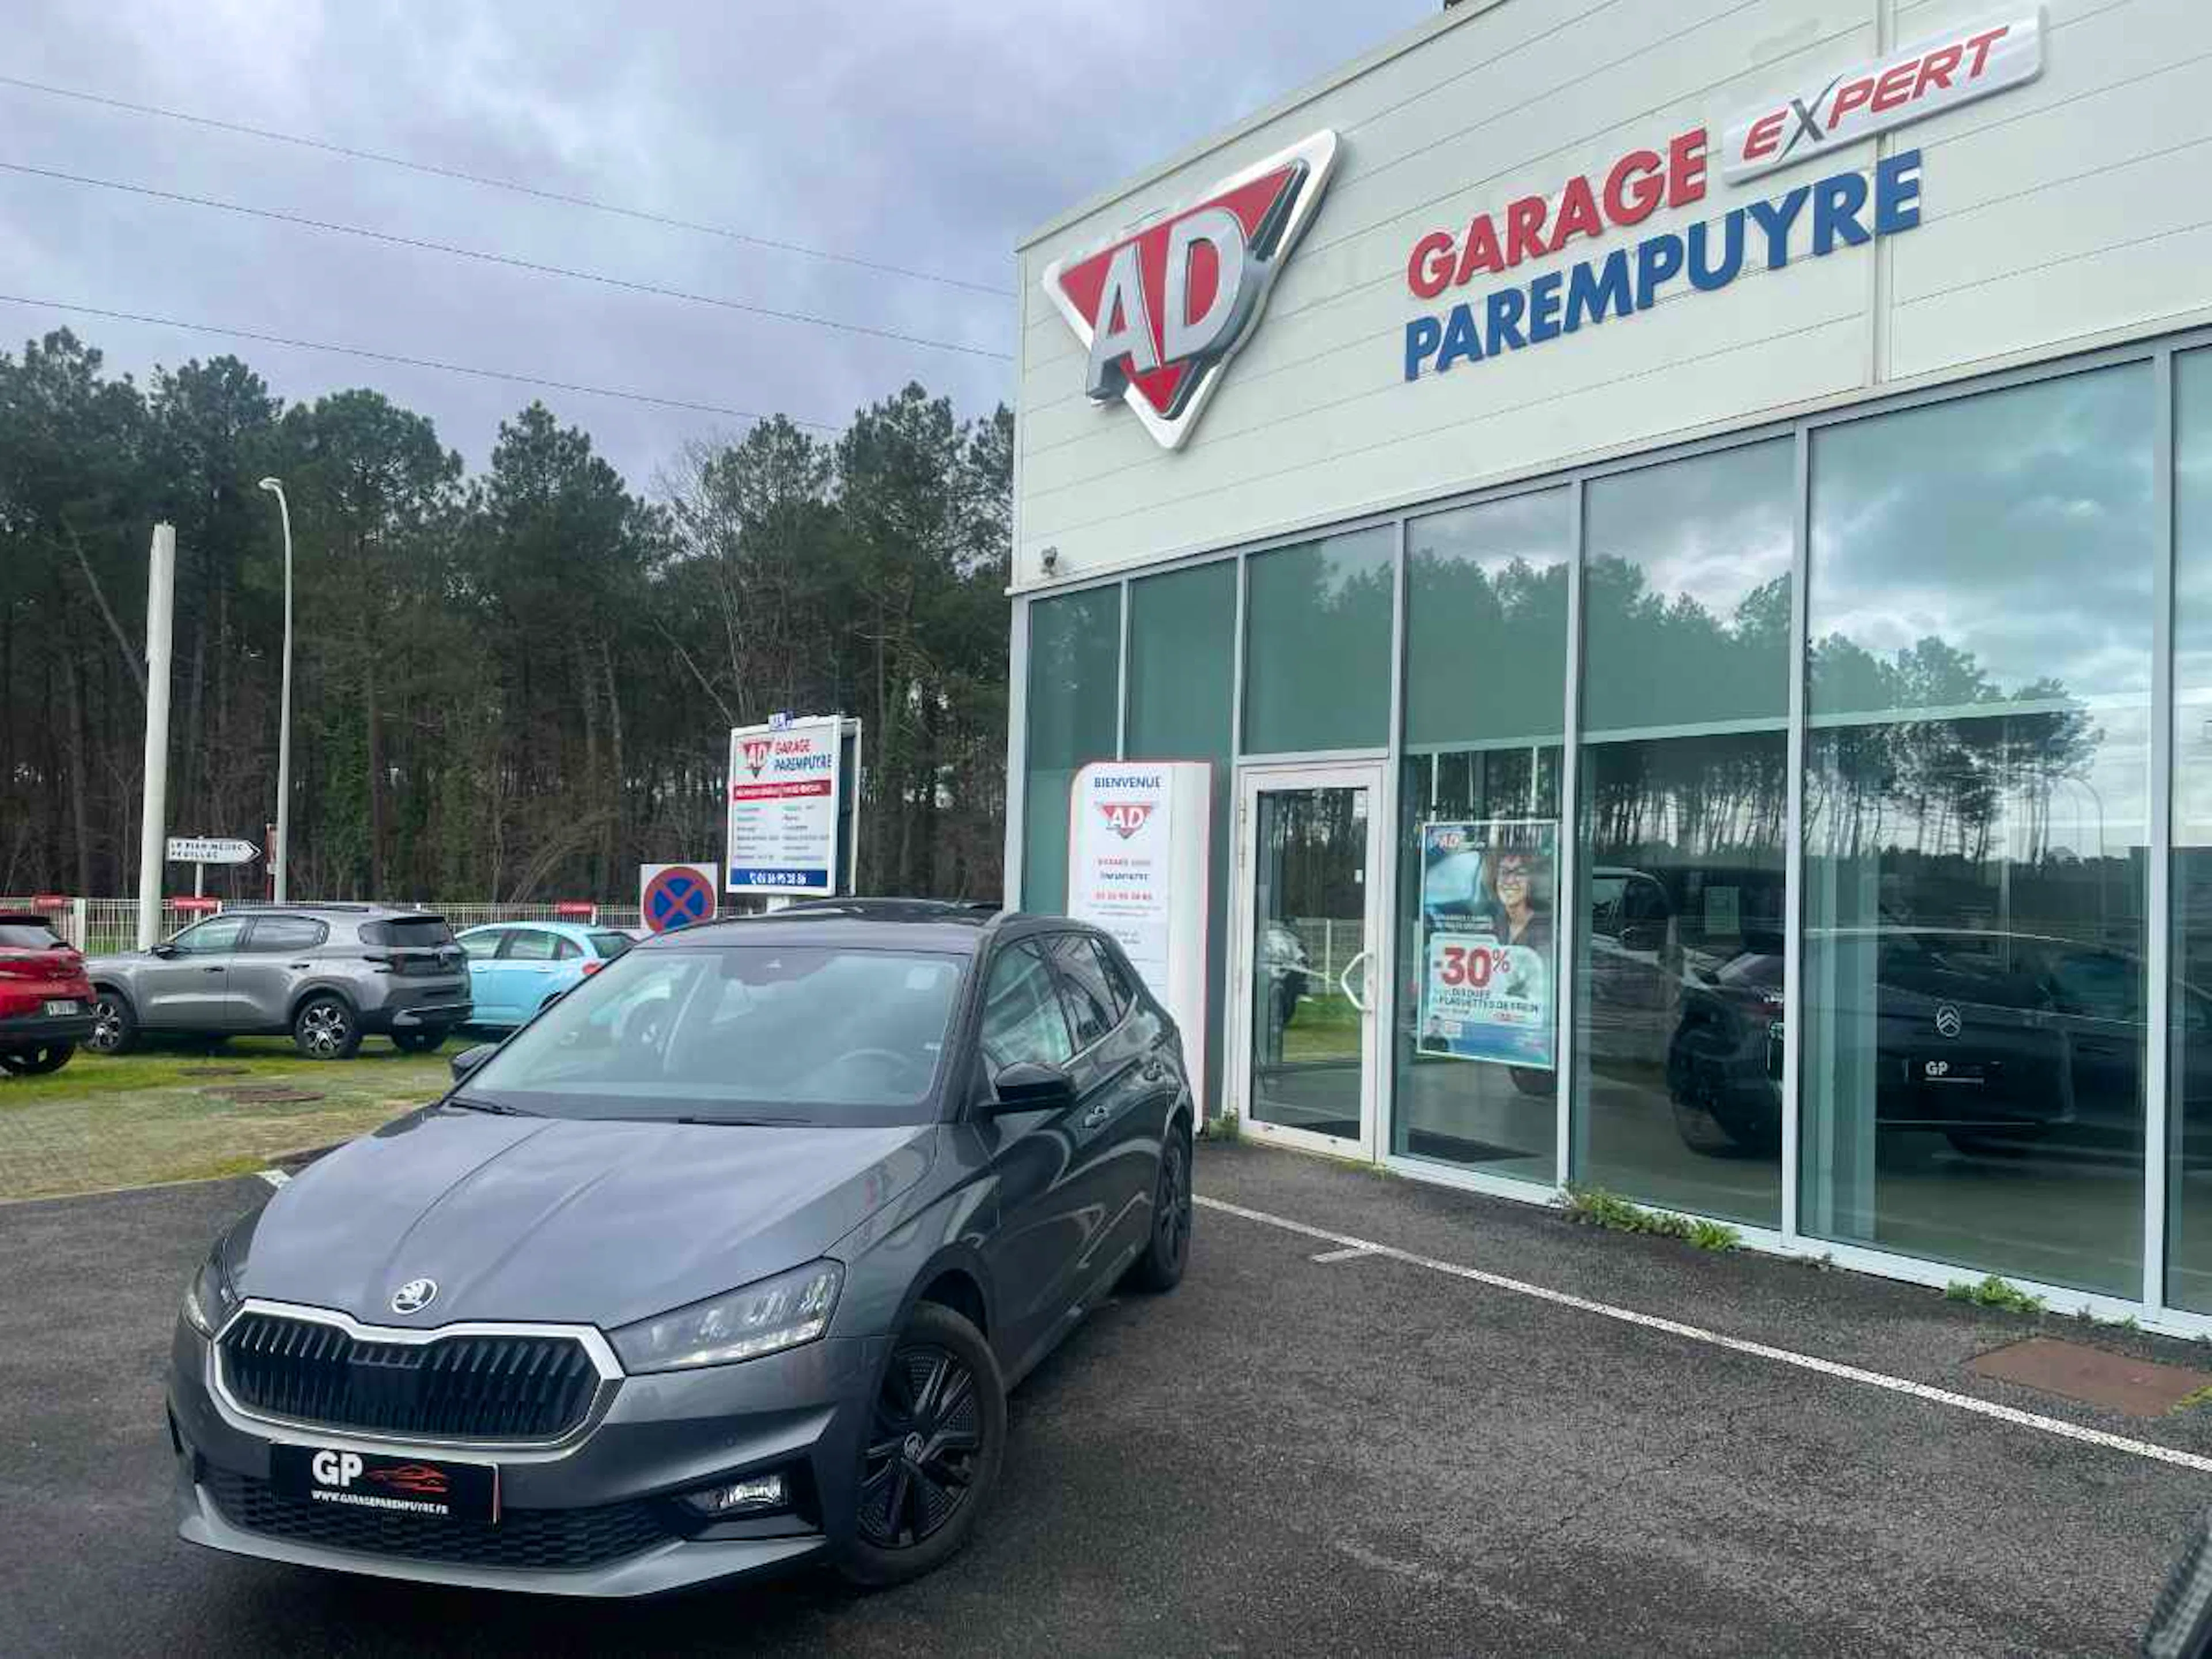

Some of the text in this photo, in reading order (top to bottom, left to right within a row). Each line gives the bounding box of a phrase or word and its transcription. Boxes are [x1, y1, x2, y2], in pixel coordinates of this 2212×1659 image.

[1743, 25, 2009, 162] EXPERT
[1407, 127, 1707, 299] GARAGE
[1404, 148, 1921, 382] PAREMPUYRE
[1086, 206, 1253, 399] AD
[747, 743, 768, 768] AD
[775, 738, 811, 755] GARAGE
[774, 753, 832, 771] PAREMPUYRE
[1094, 777, 1161, 788] BIENVENUE
[1111, 806, 1145, 828] AD
[1925, 1060, 1948, 1076] GP
[312, 1450, 363, 1487] GP
